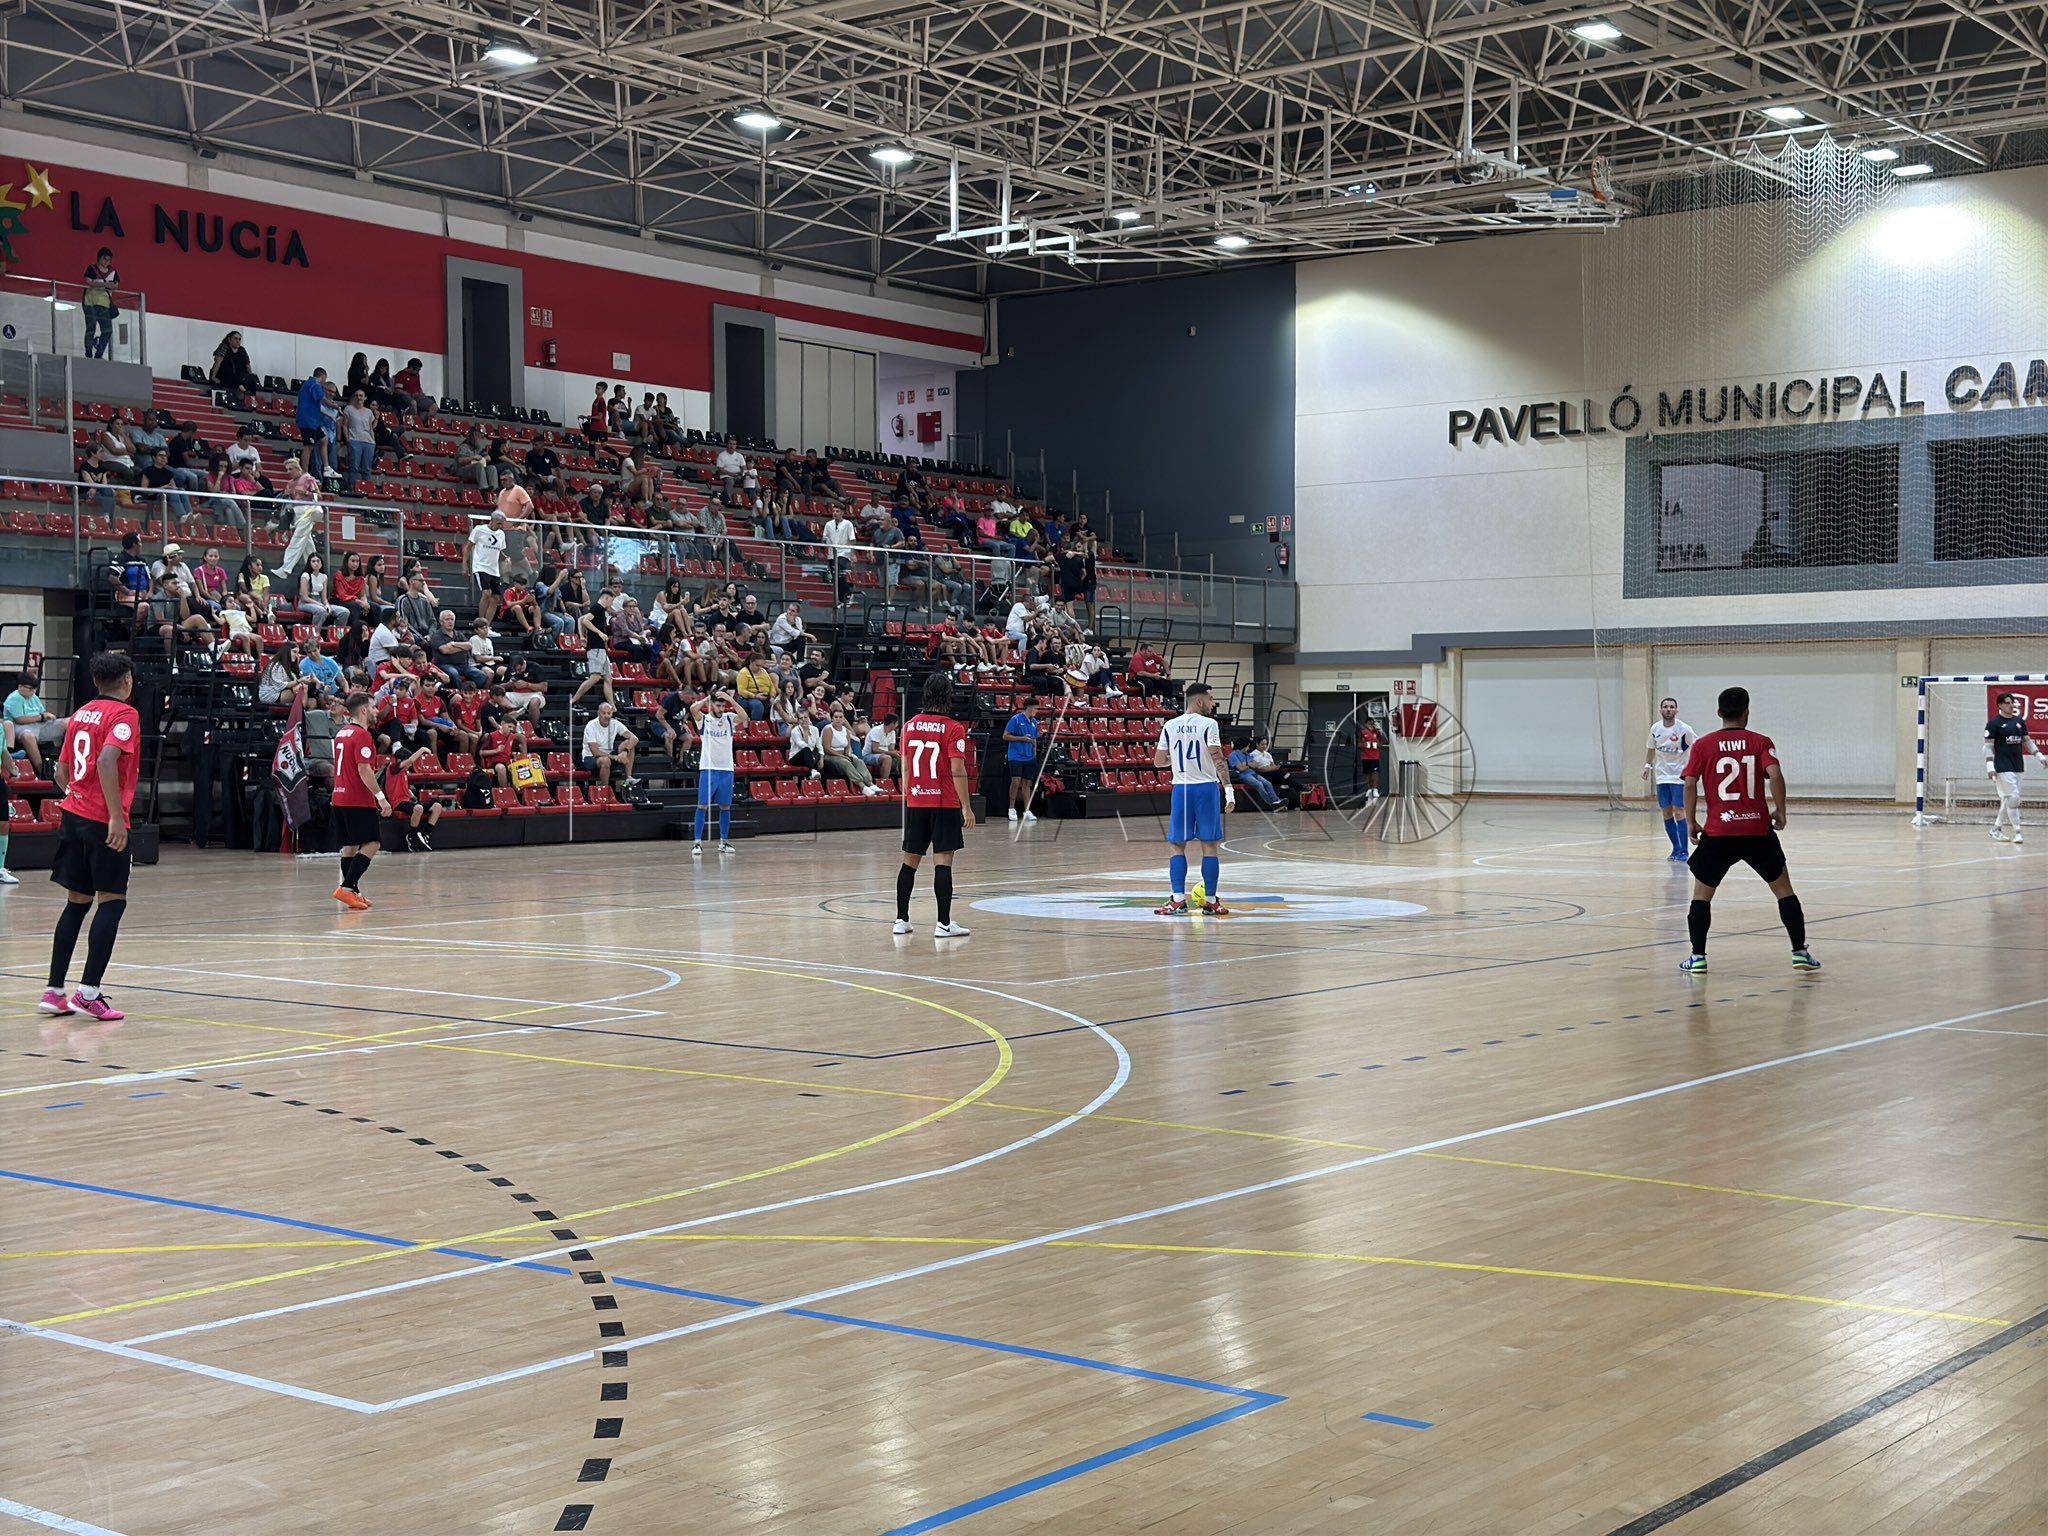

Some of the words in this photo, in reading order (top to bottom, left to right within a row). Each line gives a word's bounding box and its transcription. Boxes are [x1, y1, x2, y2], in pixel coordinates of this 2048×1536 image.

[70, 191, 125, 238] LA
[1449, 385, 1642, 446] PAVELLÓ
[1658, 370, 1925, 428] MUNICIPAL
[73, 730, 91, 781] 8
[907, 739, 941, 780] 77
[1173, 739, 1202, 773] 14
[1718, 739, 1747, 752] KIWI
[1716, 754, 1756, 802] 21
